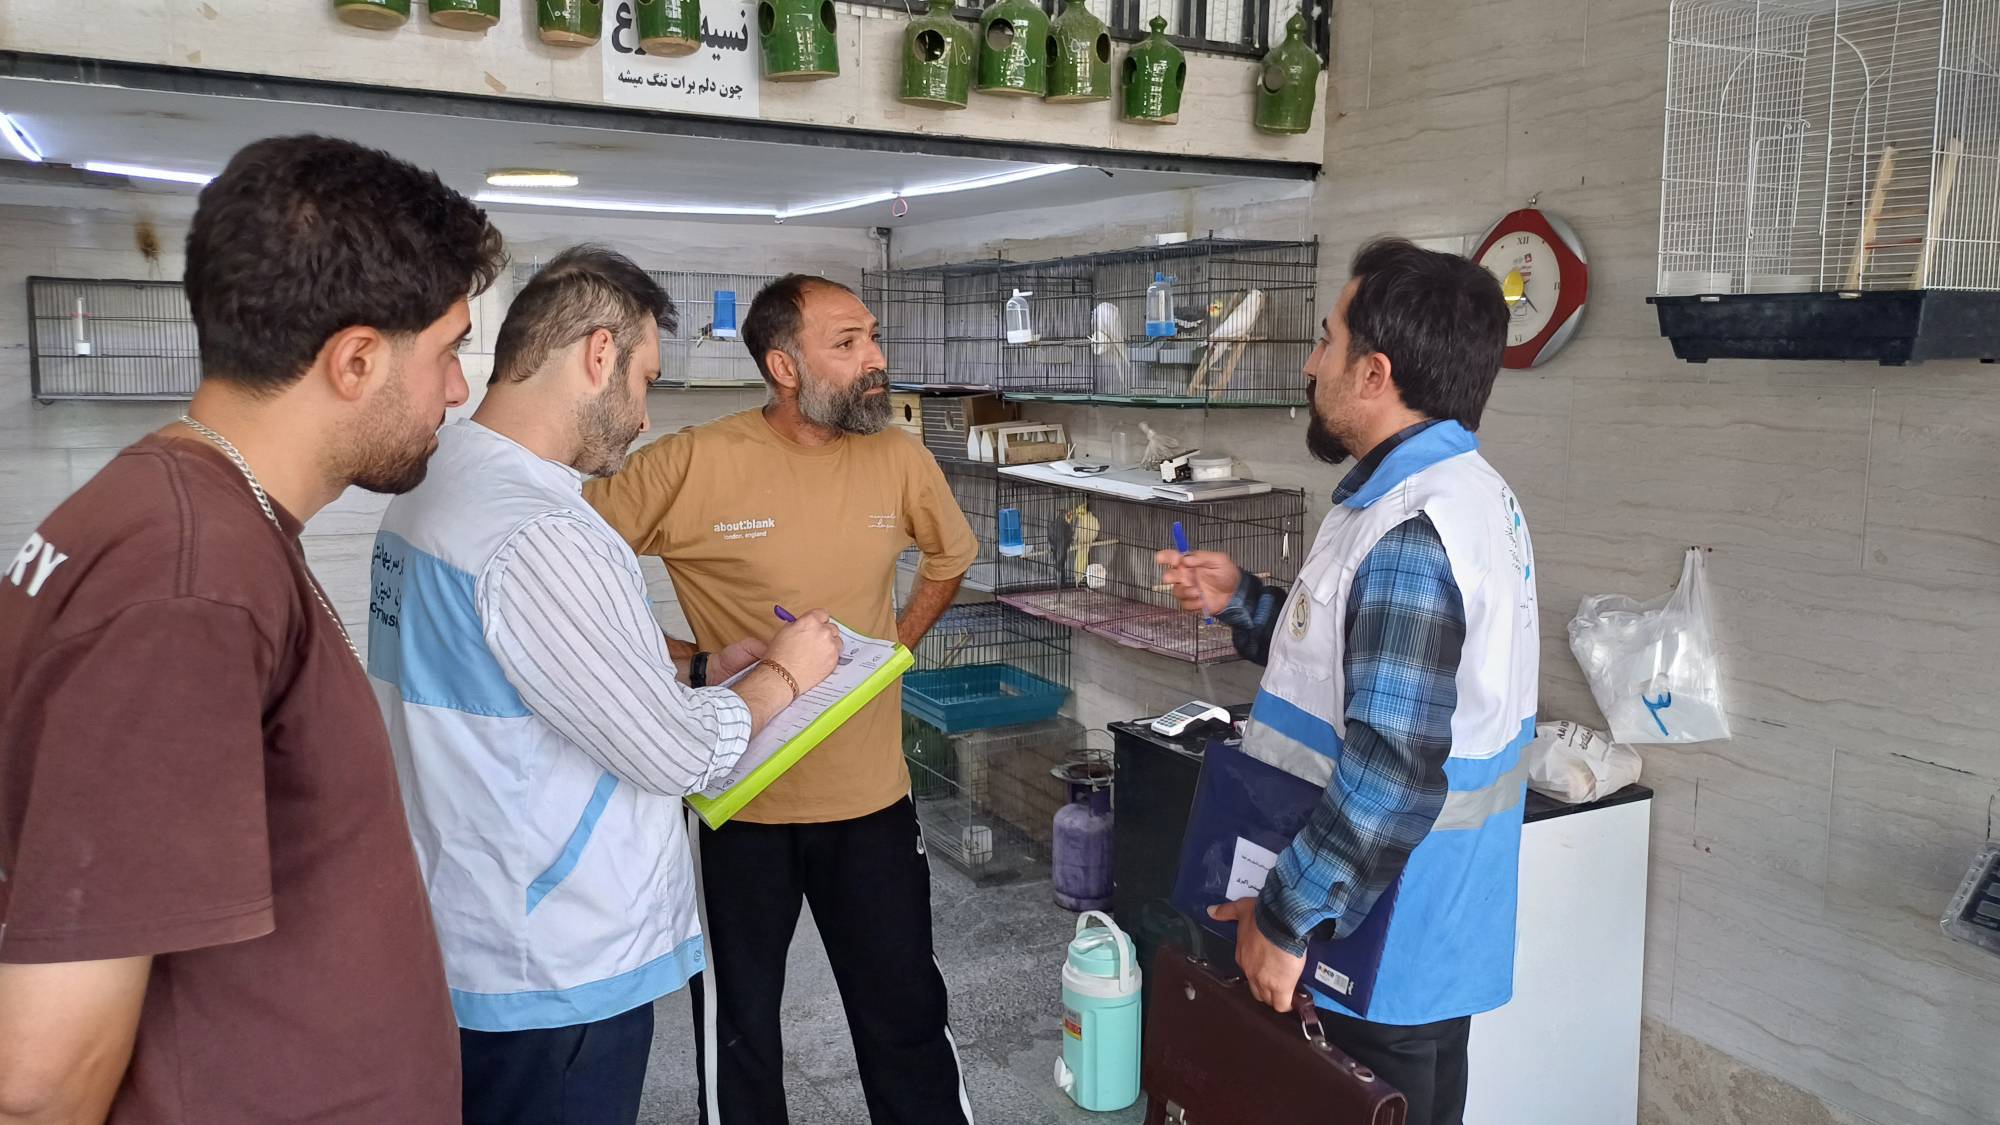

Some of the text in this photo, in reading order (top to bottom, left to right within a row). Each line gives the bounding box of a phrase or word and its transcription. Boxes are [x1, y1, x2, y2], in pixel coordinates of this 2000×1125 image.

[617, 69, 743, 100] چون دلم برات تنگ میشه
[1517, 236, 1530, 245] XII
[713, 517, 775, 532] about:blank
